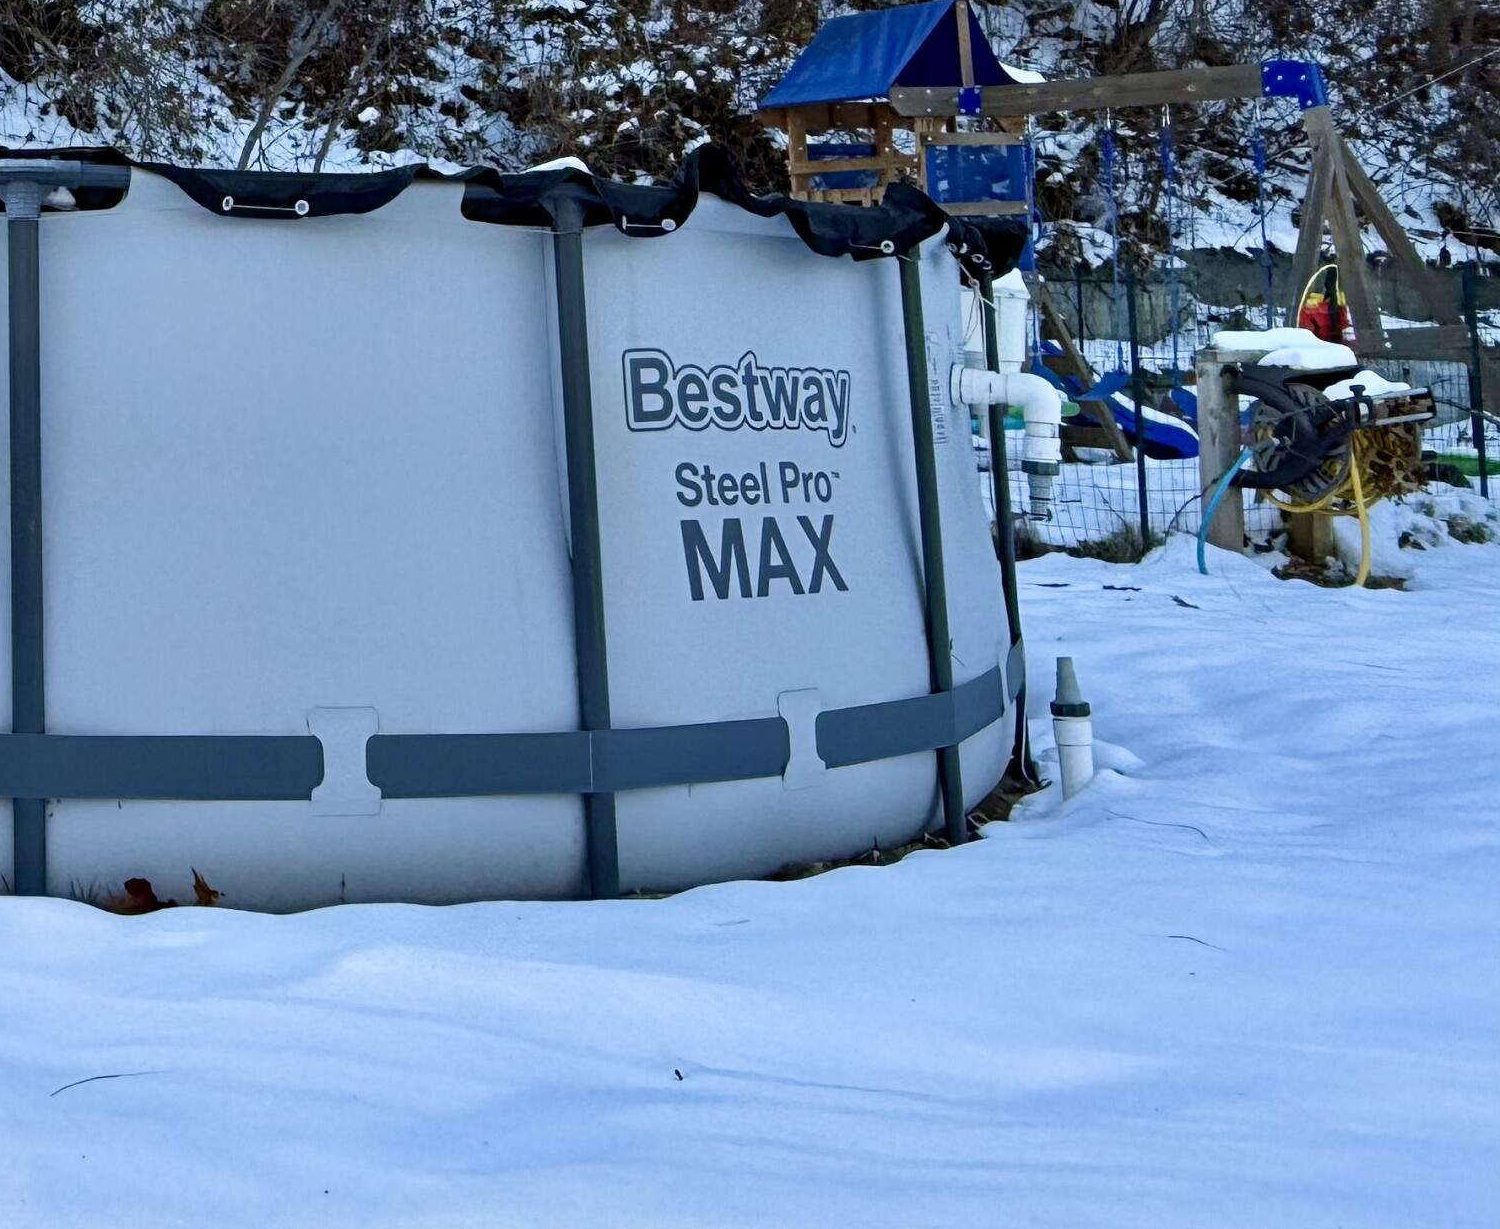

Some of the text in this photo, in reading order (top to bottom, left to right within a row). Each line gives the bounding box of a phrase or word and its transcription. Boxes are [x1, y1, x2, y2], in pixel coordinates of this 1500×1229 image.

[626, 354, 849, 441] Bestway
[675, 461, 771, 507] Steel
[680, 514, 849, 601] MAX
